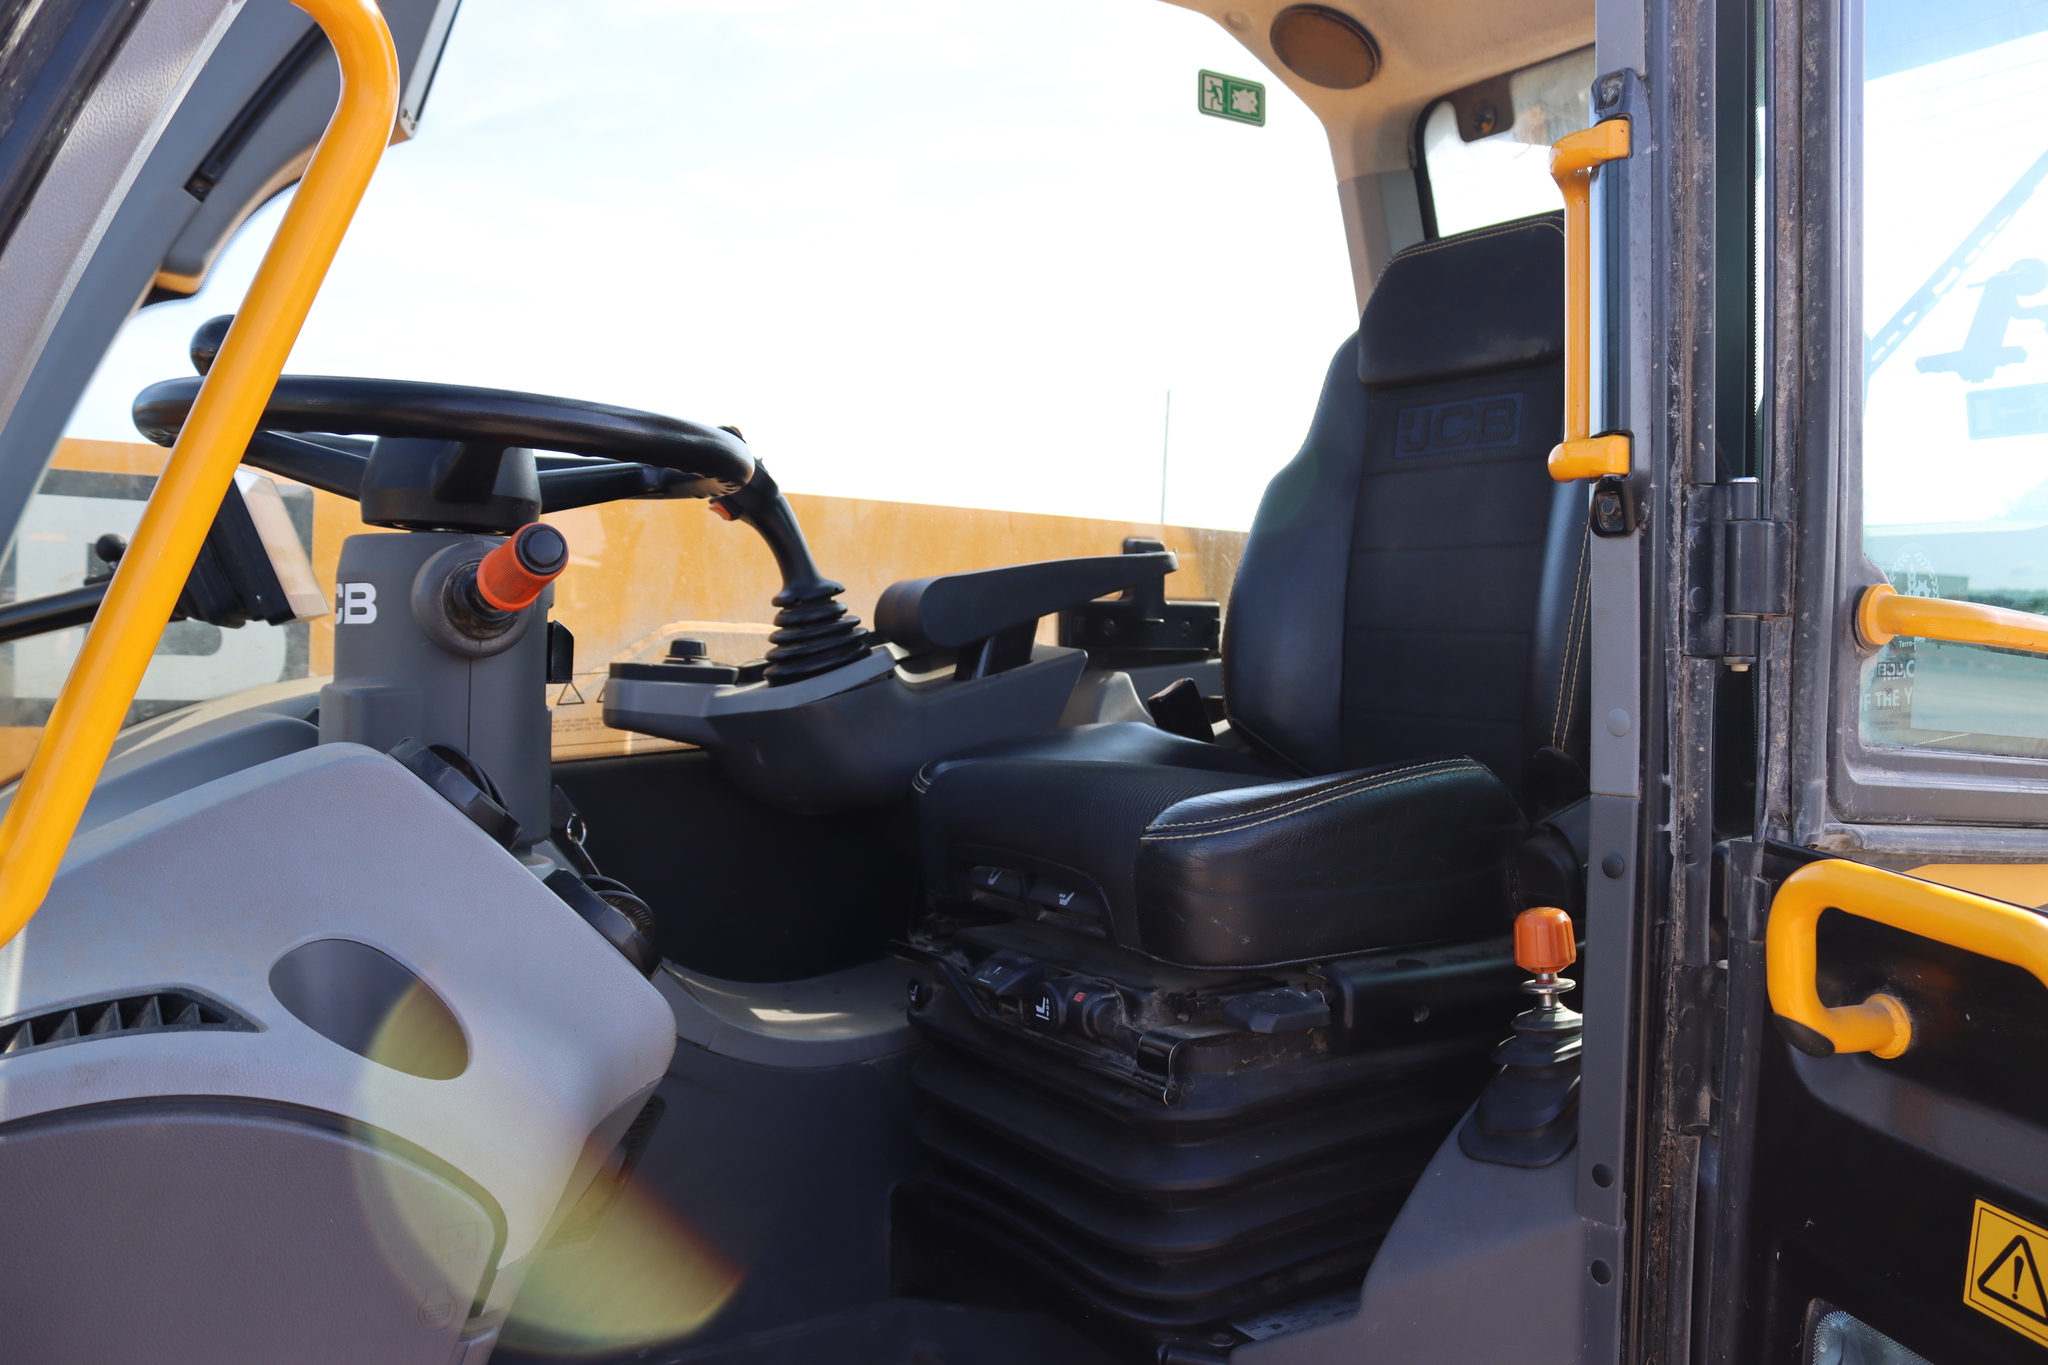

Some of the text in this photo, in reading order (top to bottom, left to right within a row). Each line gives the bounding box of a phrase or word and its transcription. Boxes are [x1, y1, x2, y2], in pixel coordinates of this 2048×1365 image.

[1399, 398, 1517, 453] JCB
[335, 582, 377, 625] B
[1860, 693, 1871, 711] F
[1875, 689, 1900, 708] THE
